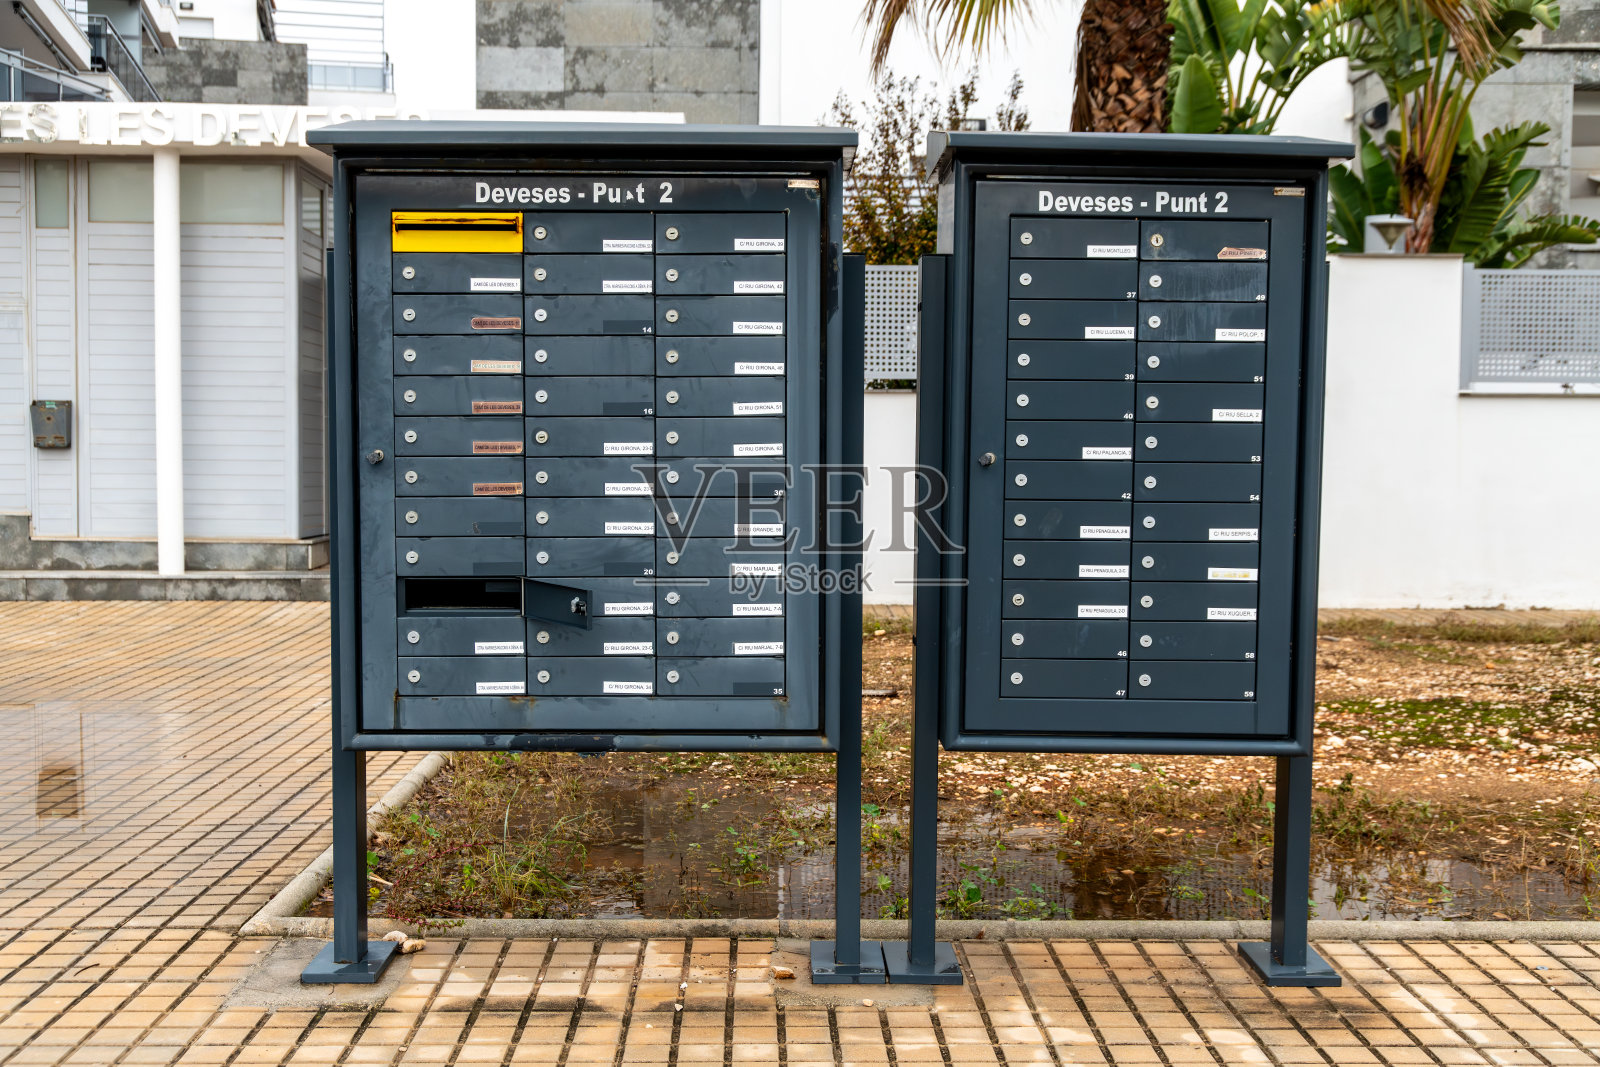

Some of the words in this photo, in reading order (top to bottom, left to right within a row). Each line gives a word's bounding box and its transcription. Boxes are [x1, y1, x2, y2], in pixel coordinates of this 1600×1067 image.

[78, 105, 175, 146] LES
[475, 182, 571, 203] Deveses
[593, 182, 645, 203] Put
[659, 181, 673, 203] 2
[1038, 191, 1134, 213] Deveses
[1155, 191, 1208, 213] Punt
[1214, 191, 1229, 213] 2
